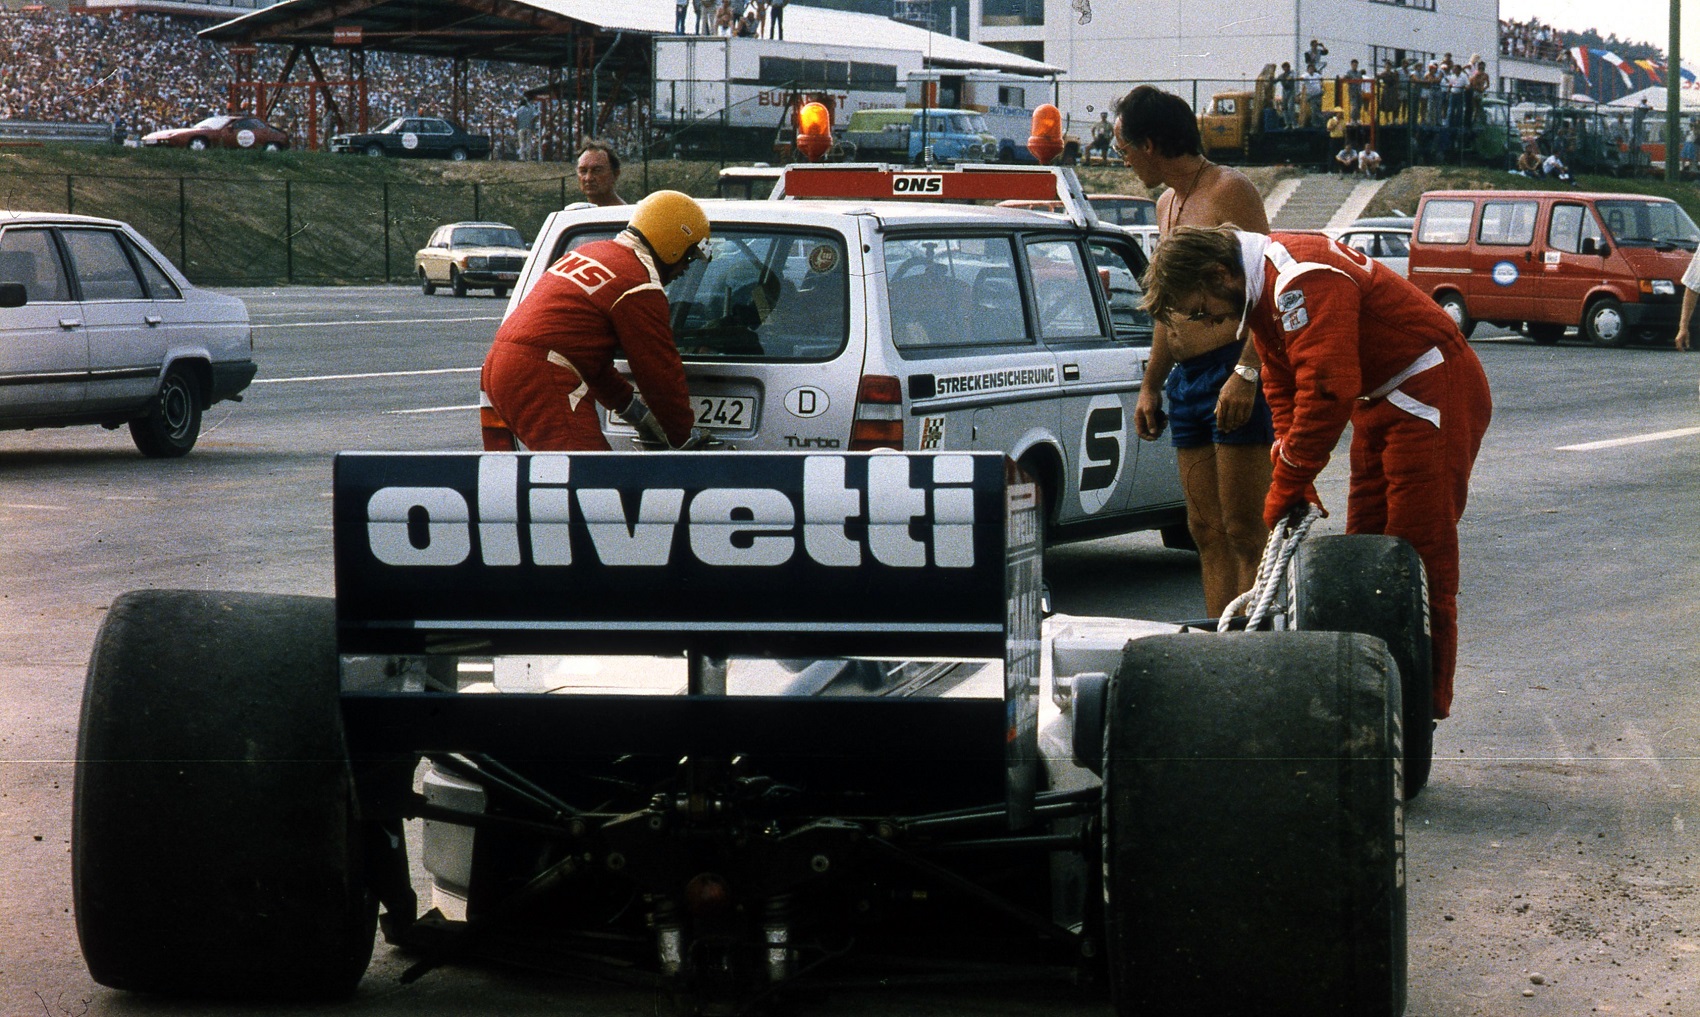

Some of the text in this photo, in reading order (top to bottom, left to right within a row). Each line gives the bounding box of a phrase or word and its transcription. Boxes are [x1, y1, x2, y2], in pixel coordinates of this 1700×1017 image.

[893, 177, 941, 192] ONS
[936, 367, 1055, 395] STRECKENSICHERUNG
[698, 399, 744, 425] 242
[798, 390, 816, 414] D
[784, 435, 841, 449] Turbo
[1079, 406, 1123, 492] S
[366, 454, 975, 568] olivetti
